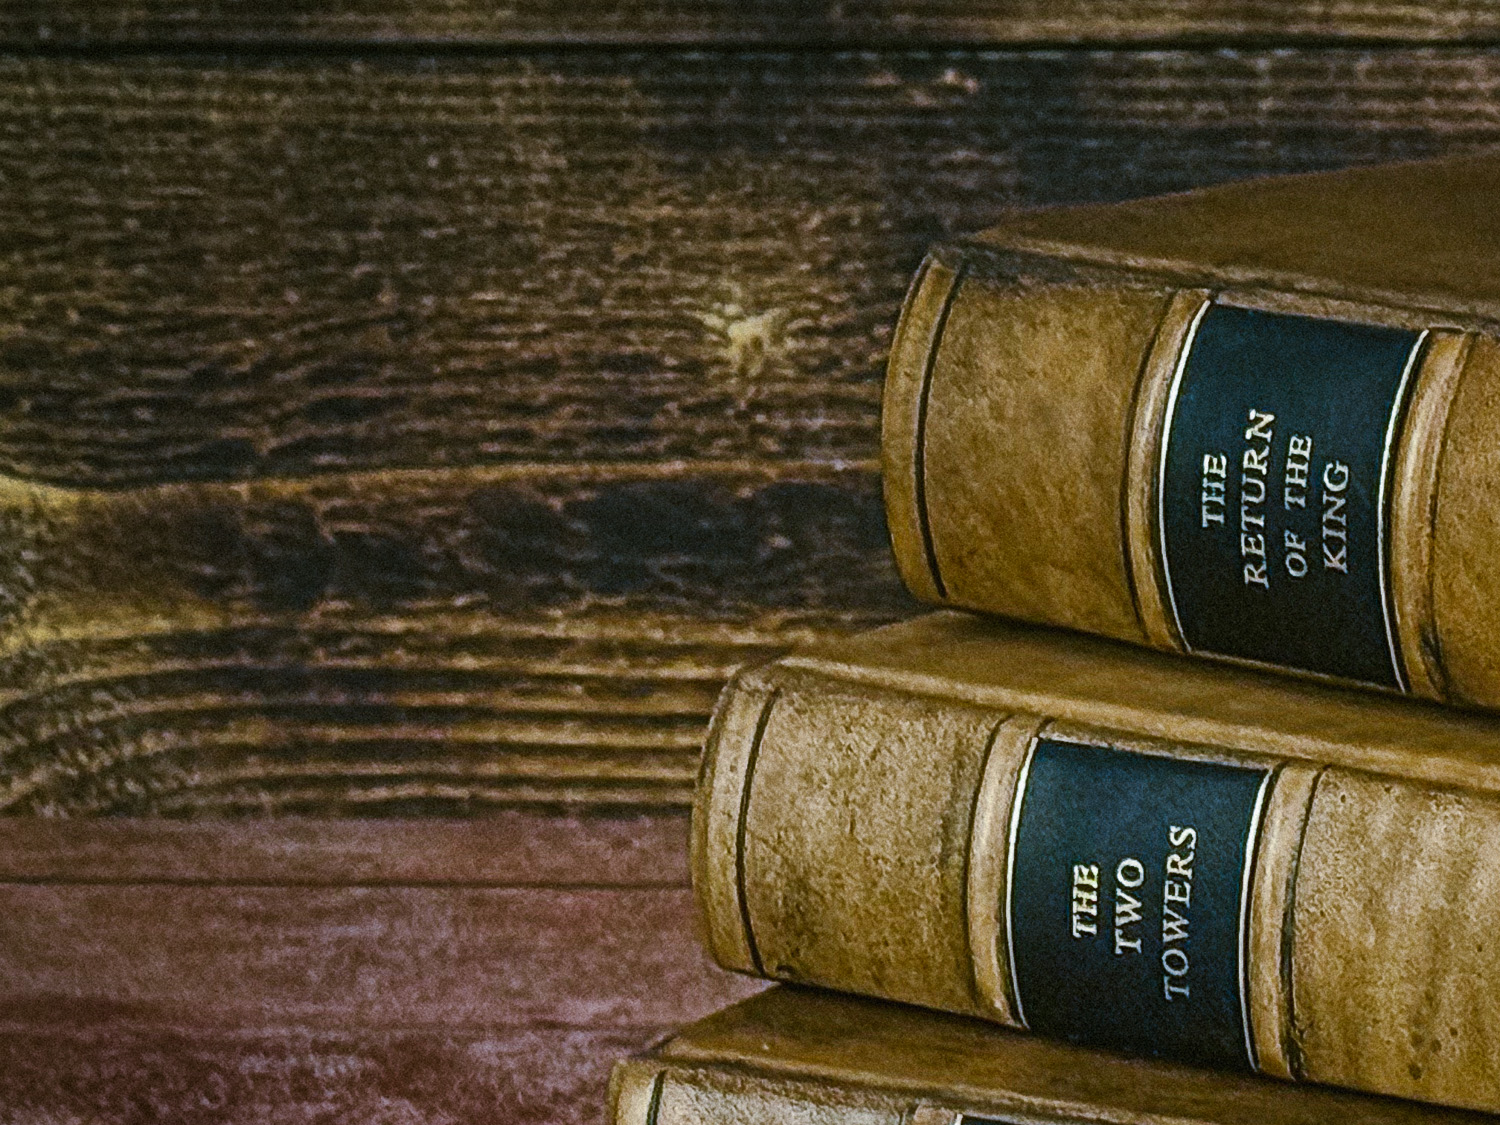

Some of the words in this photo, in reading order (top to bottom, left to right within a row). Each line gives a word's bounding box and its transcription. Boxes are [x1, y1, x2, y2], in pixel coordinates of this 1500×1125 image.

[1202, 453, 1227, 528] THE
[1241, 408, 1276, 589] RETURN
[1285, 434, 1312, 510] THE
[1285, 529, 1308, 578] OF
[1322, 460, 1349, 574] KING
[1072, 864, 1099, 938] THE
[1115, 858, 1145, 954] TWO
[1161, 825, 1197, 1001] TOWERS
